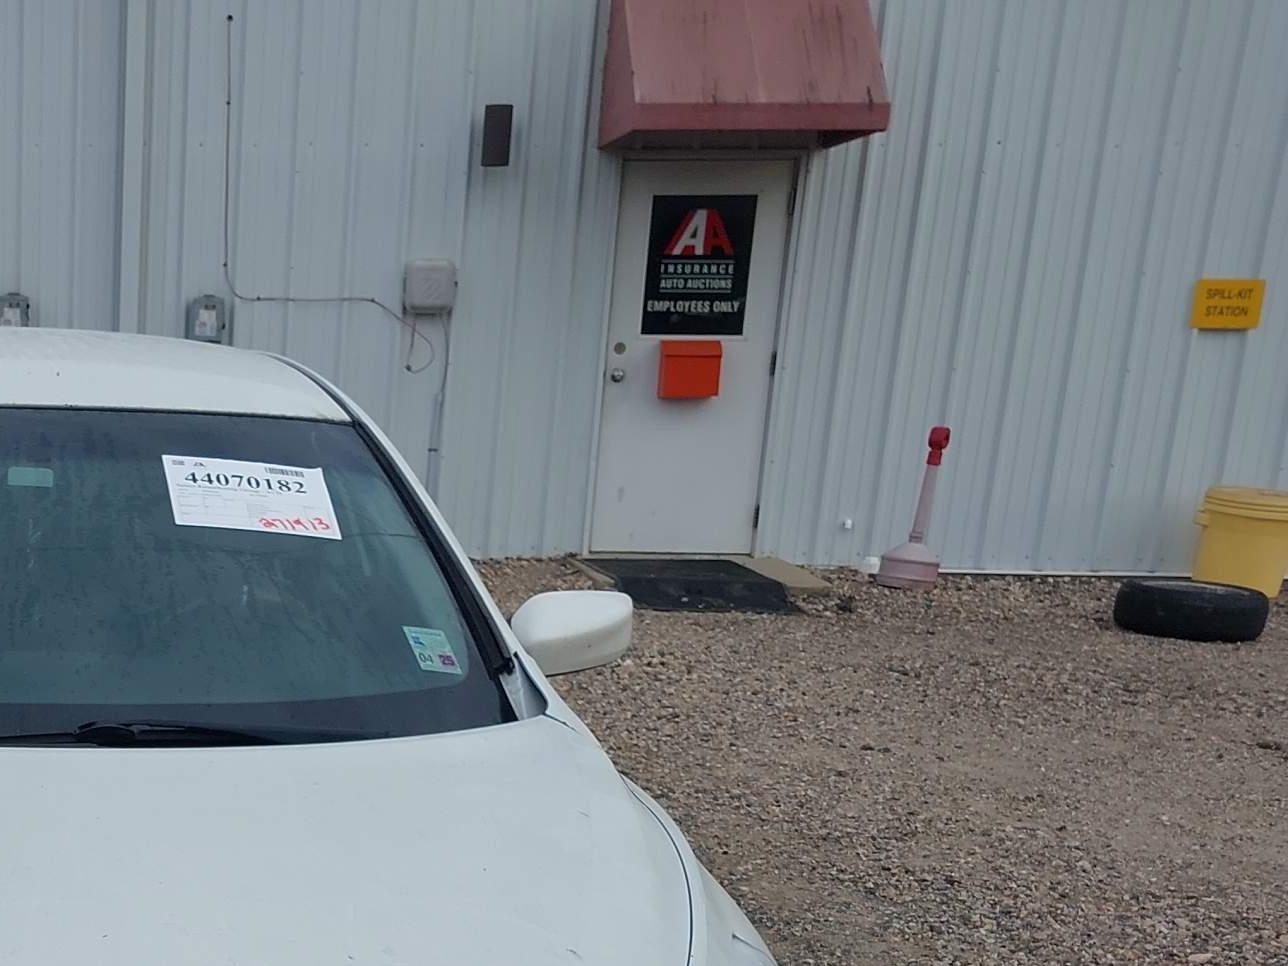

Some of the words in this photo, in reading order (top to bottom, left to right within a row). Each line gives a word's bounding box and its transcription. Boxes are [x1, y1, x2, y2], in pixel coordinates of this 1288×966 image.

[660, 263, 735, 274] INSURANCE
[660, 279, 685, 289] AUTO
[686, 279, 733, 289] AUCTIONS
[647, 301, 711, 312] EMPLOYEES
[713, 301, 740, 313] ONLY
[1206, 305, 1249, 317] STATION
[184, 472, 307, 494] 44070182
